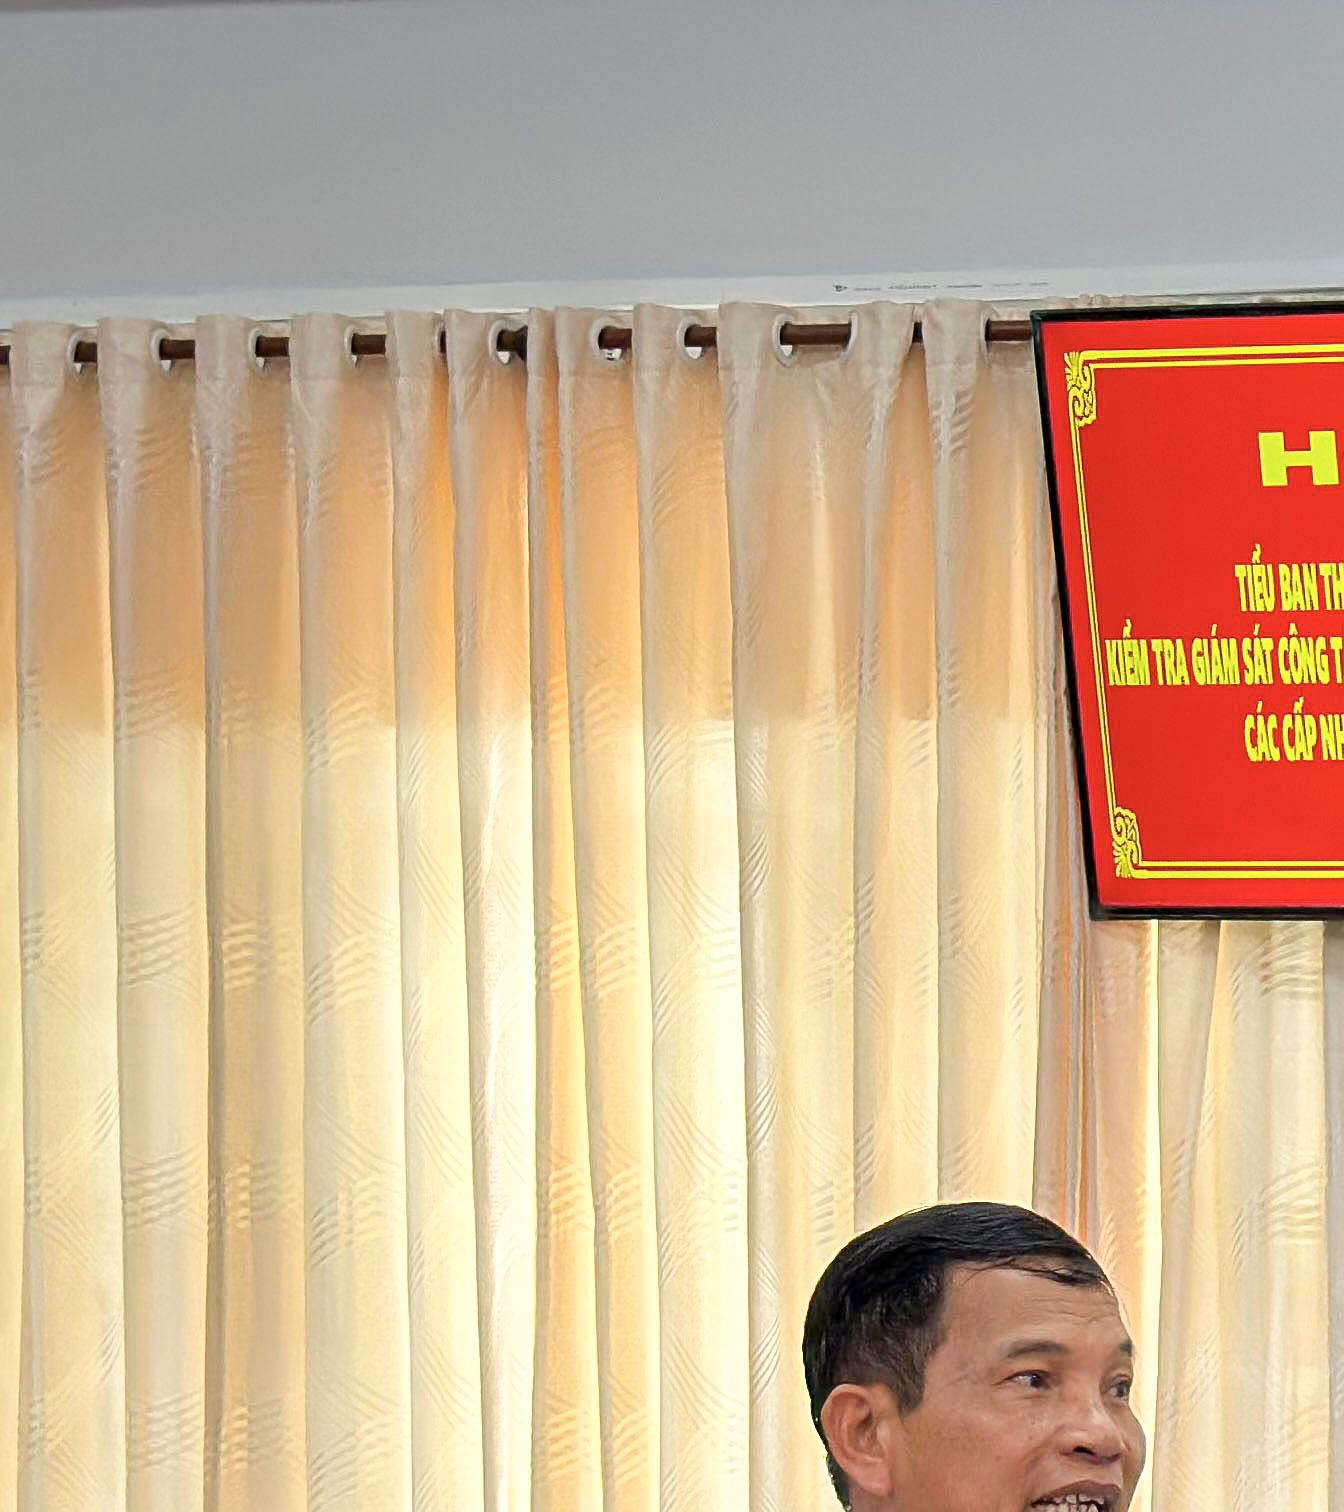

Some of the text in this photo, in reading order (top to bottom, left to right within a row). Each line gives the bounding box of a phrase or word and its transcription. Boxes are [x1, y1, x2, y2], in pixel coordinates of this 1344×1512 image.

[1234, 543, 1275, 612] TIỂU
[1278, 563, 1319, 611] BAN
[1104, 619, 1151, 686] KIỂM
[1151, 638, 1190, 686] TRA
[1191, 623, 1241, 686] GIÁM
[1242, 623, 1274, 685] SÁT
[1278, 622, 1330, 685] CÔNG
[1244, 700, 1281, 762] CÁC
[1282, 697, 1318, 762] CẤP
